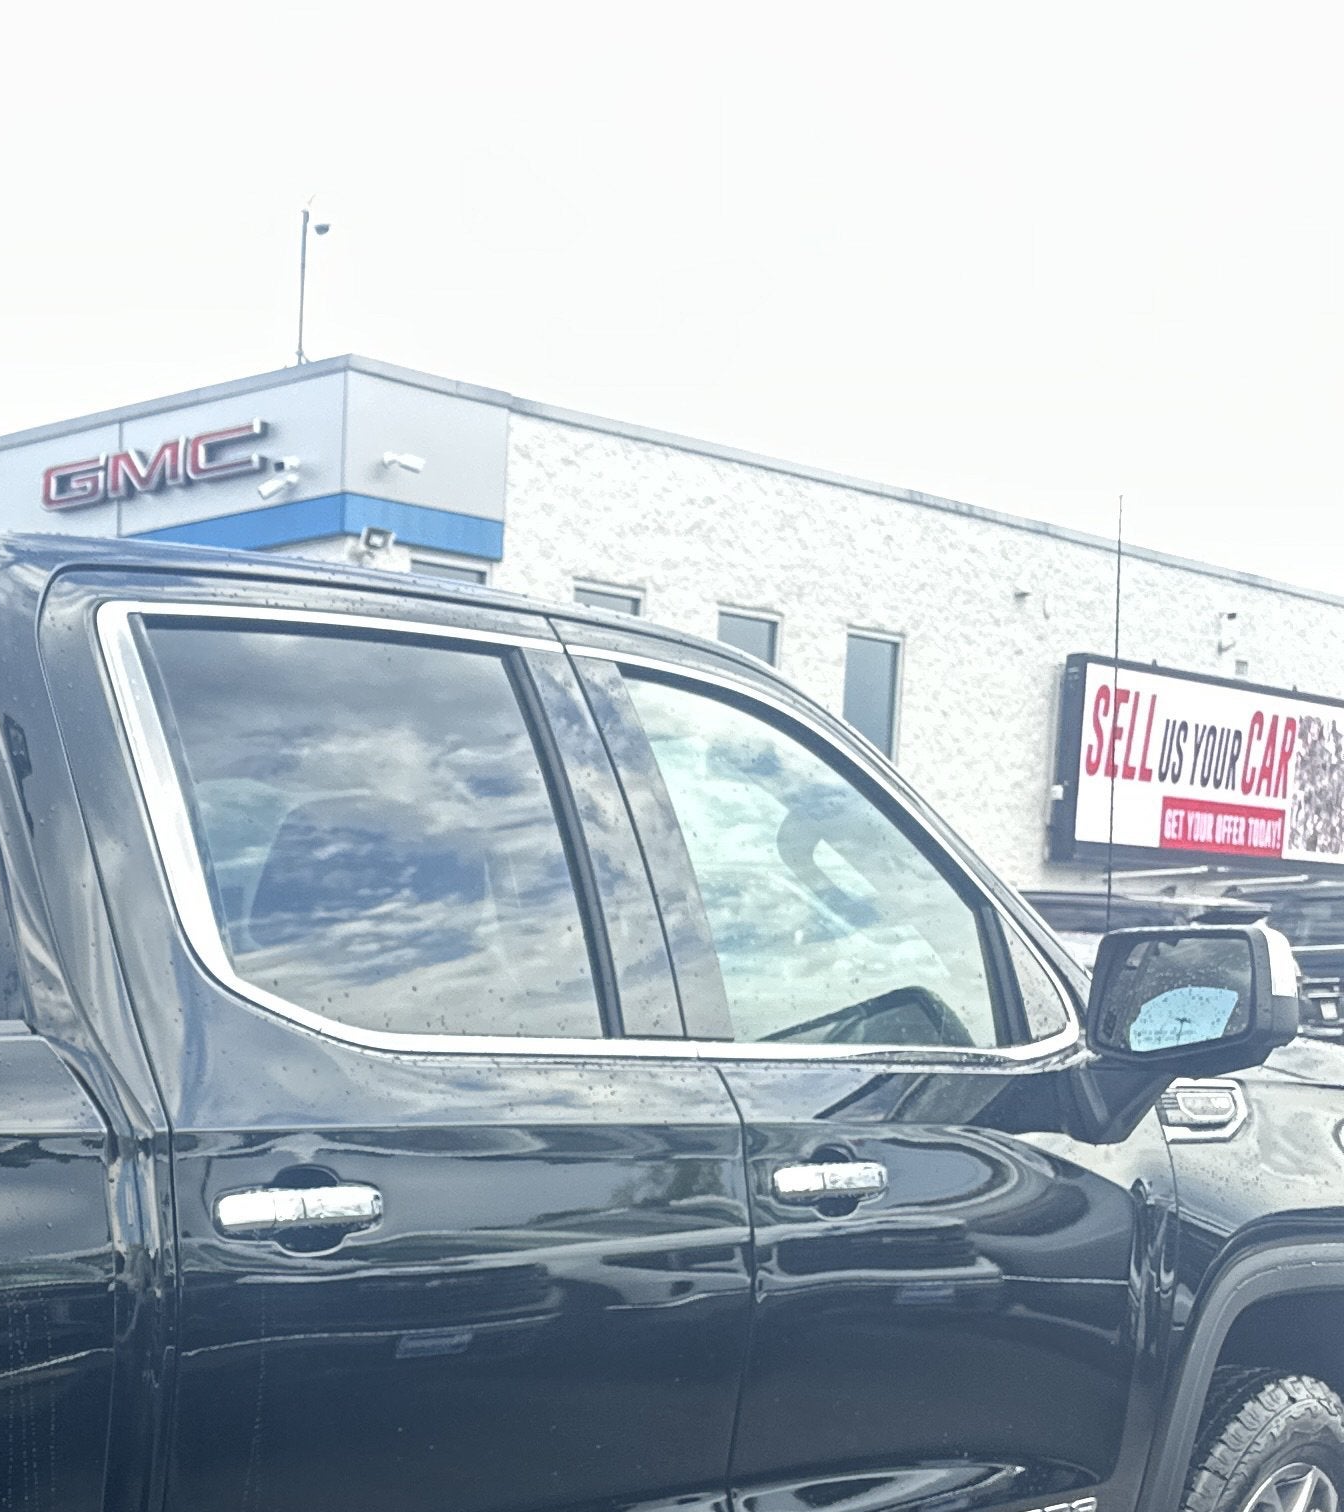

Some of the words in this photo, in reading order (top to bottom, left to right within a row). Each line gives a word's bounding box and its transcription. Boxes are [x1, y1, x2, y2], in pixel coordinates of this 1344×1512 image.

[40, 417, 265, 512] GMC
[1085, 684, 1157, 783] SELL
[1159, 718, 1189, 784] US
[1189, 722, 1242, 791] YOUR
[1241, 710, 1297, 799] CAR
[1164, 808, 1185, 840] GET
[1186, 810, 1214, 843] YOUR
[1215, 813, 1246, 846] OFFER
[1247, 817, 1282, 850] TODAY!
